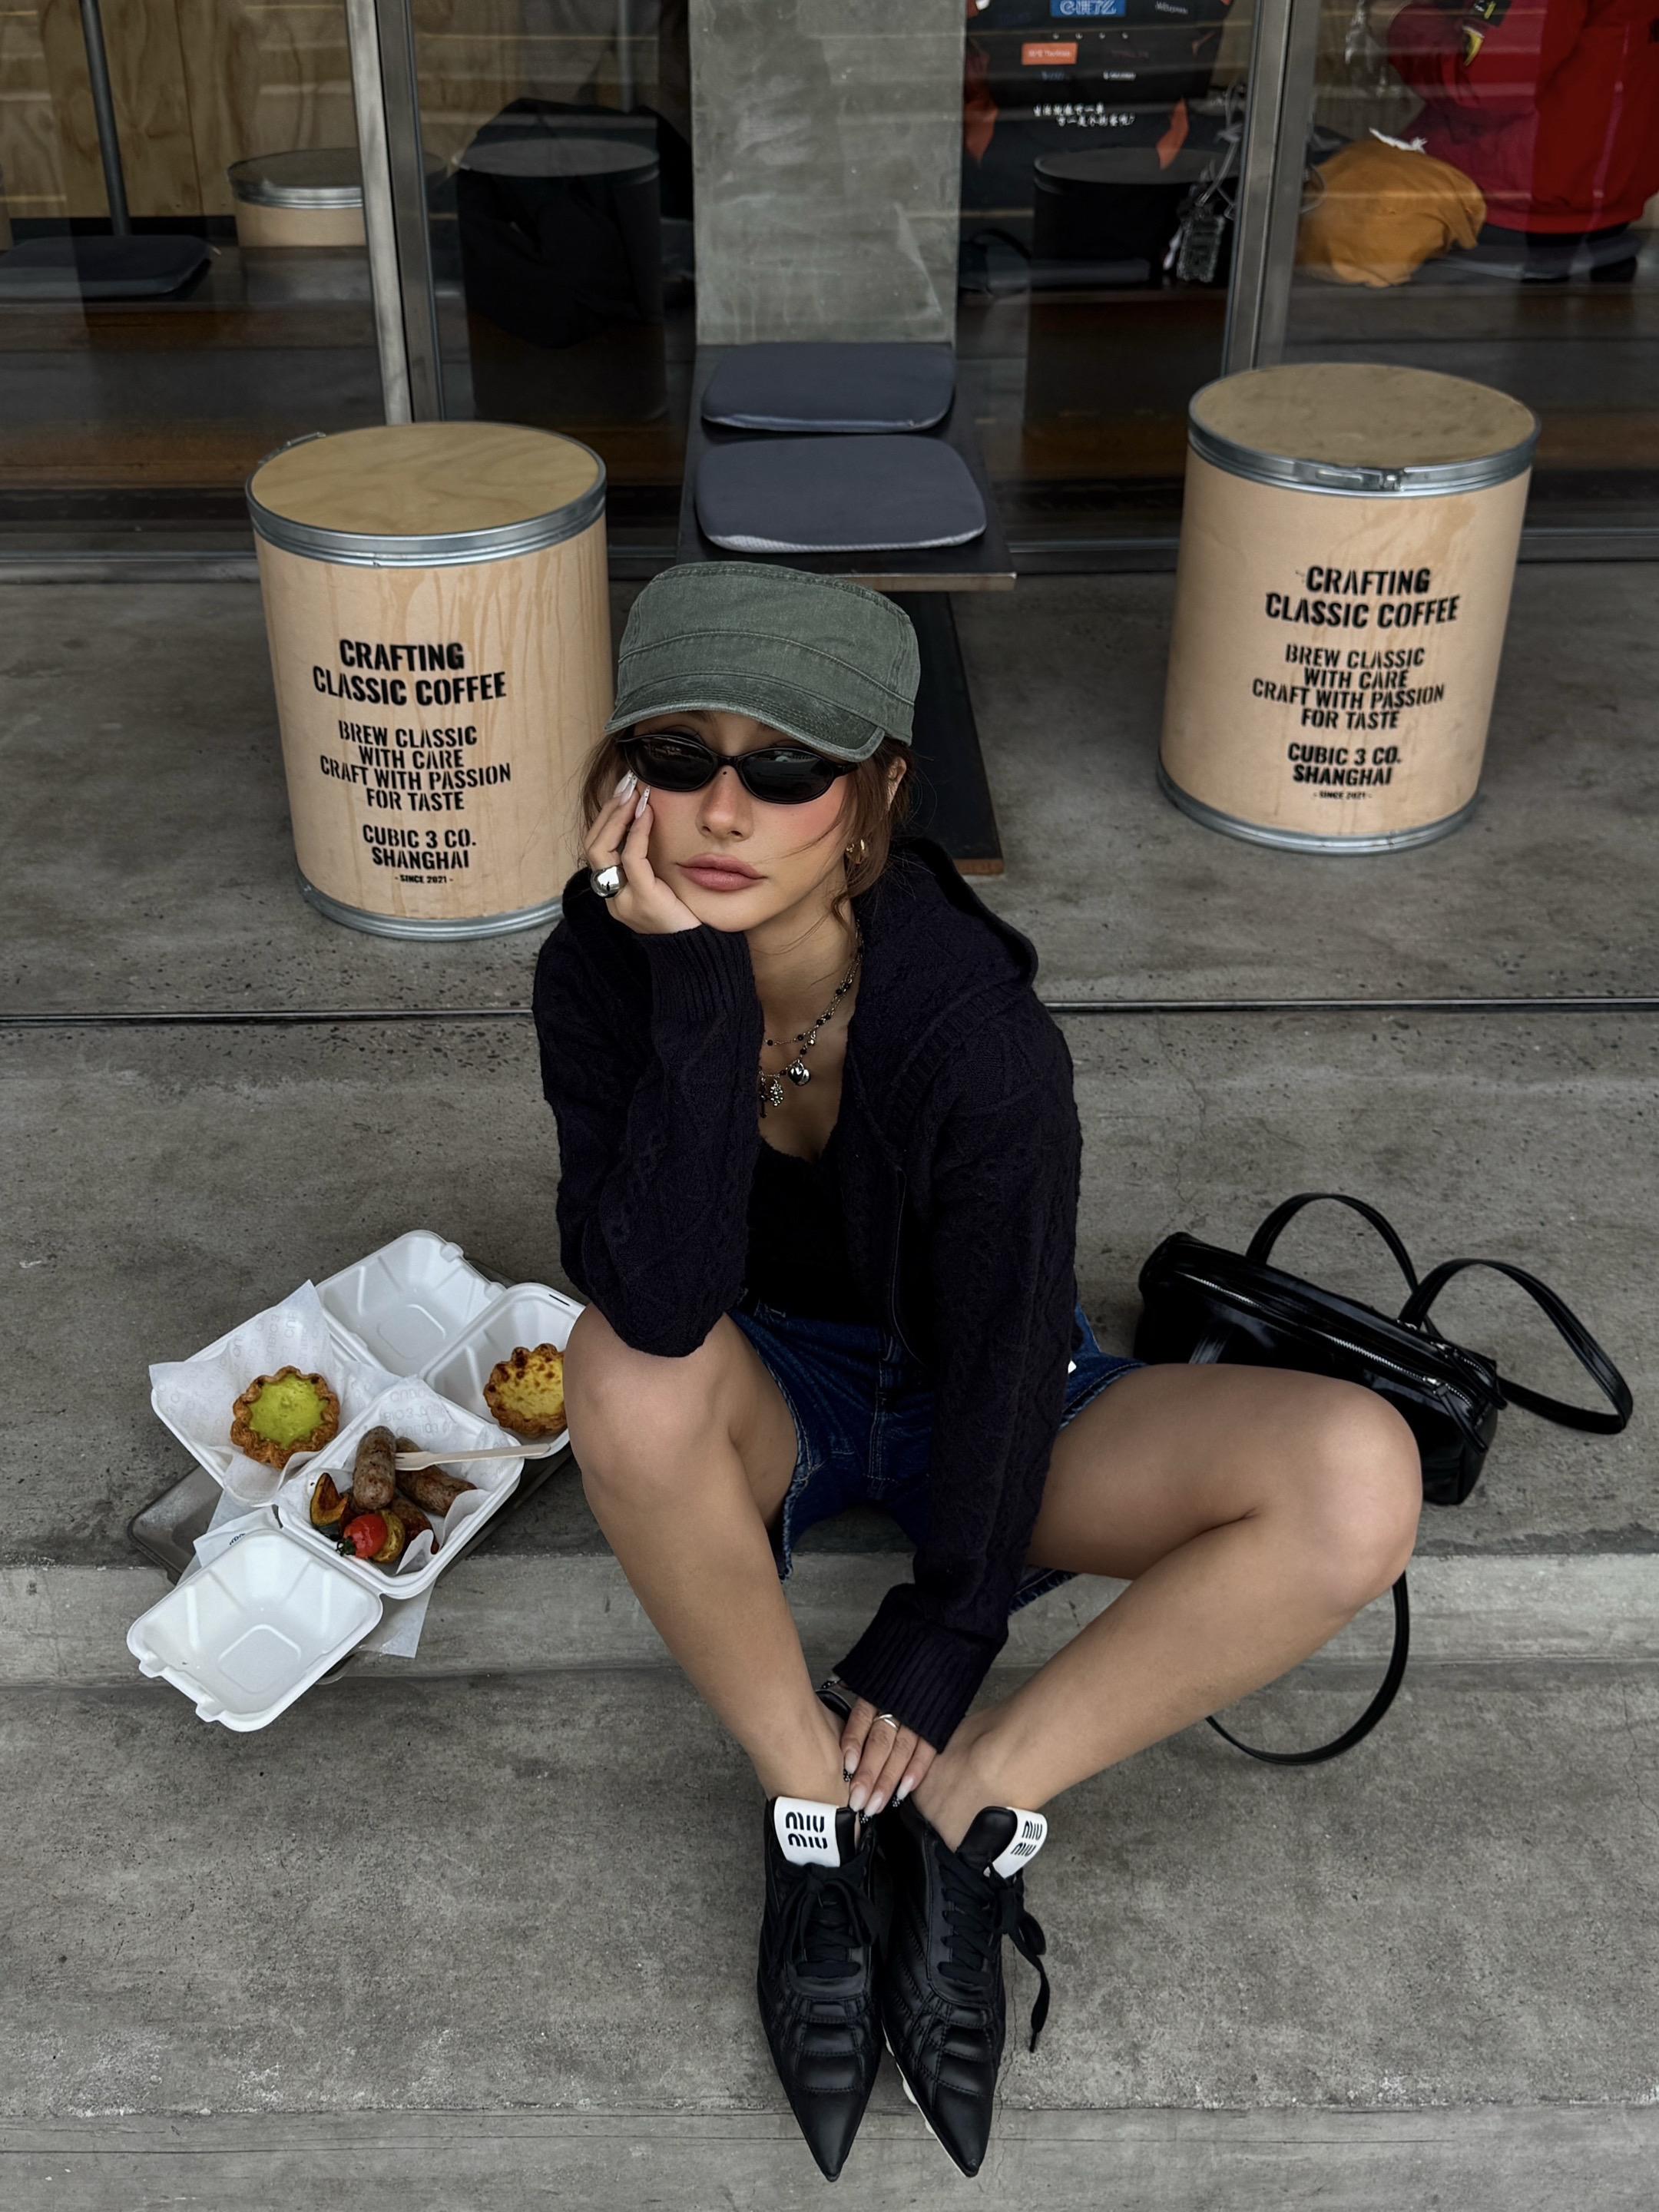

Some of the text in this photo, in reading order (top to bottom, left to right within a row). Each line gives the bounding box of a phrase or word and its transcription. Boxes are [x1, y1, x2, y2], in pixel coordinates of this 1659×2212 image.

[1306, 565, 1431, 596] CRAFTING
[1266, 592, 1460, 628] CLASSIC COFFEE
[339, 639, 465, 671] CRAFTING
[1285, 644, 1426, 669] BREW CLASSIC
[313, 666, 507, 706] CLASSIC COFFEE
[1304, 667, 1409, 690] WITH CARE
[1252, 678, 1445, 710] CRAFT WITH PASSION
[1301, 709, 1400, 730] FOR TASTE
[338, 720, 477, 748] BREW CLASSIC
[359, 745, 465, 770] WITH CARE
[1287, 742, 1402, 766] CUBIC 3 CO.
[320, 755, 512, 790] CRAFT WITH PASSION
[1293, 765, 1393, 786] SHANGHAI
[366, 788, 465, 811] FOR TASTE
[363, 824, 476, 849] CUBIC 3 CO.
[372, 846, 469, 869] SHANGHAI
[399, 874, 447, 883] SINCE 2021
